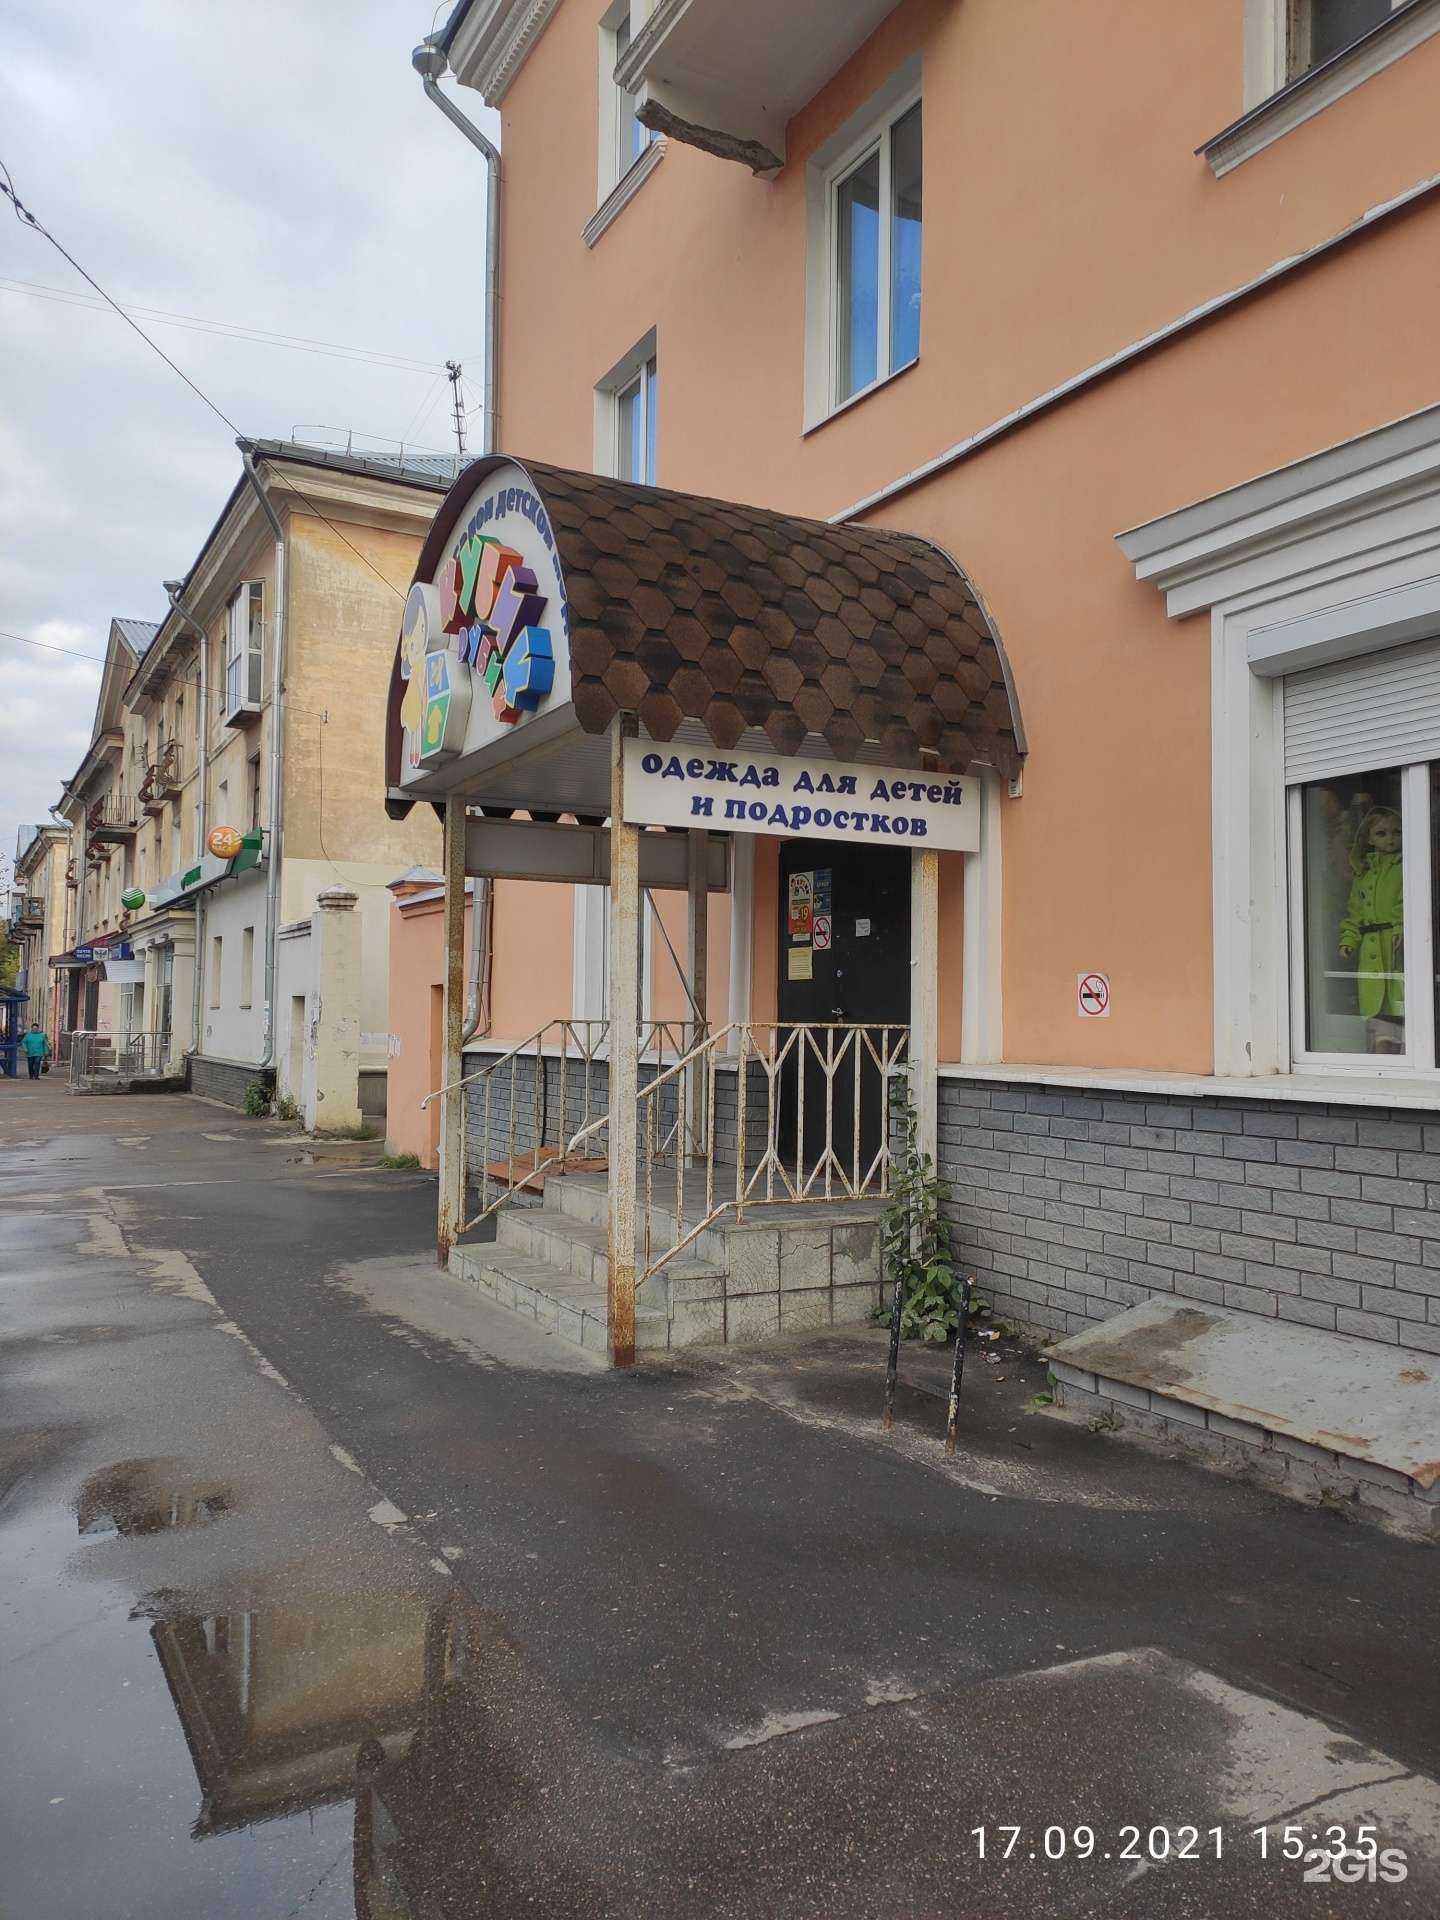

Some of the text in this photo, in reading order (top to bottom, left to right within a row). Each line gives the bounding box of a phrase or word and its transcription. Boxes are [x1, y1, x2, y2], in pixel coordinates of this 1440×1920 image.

[495, 487, 554, 551] детской
[641, 753, 963, 805] одежда для детей
[213, 832, 232, 846] 24
[690, 795, 928, 837] и подростков
